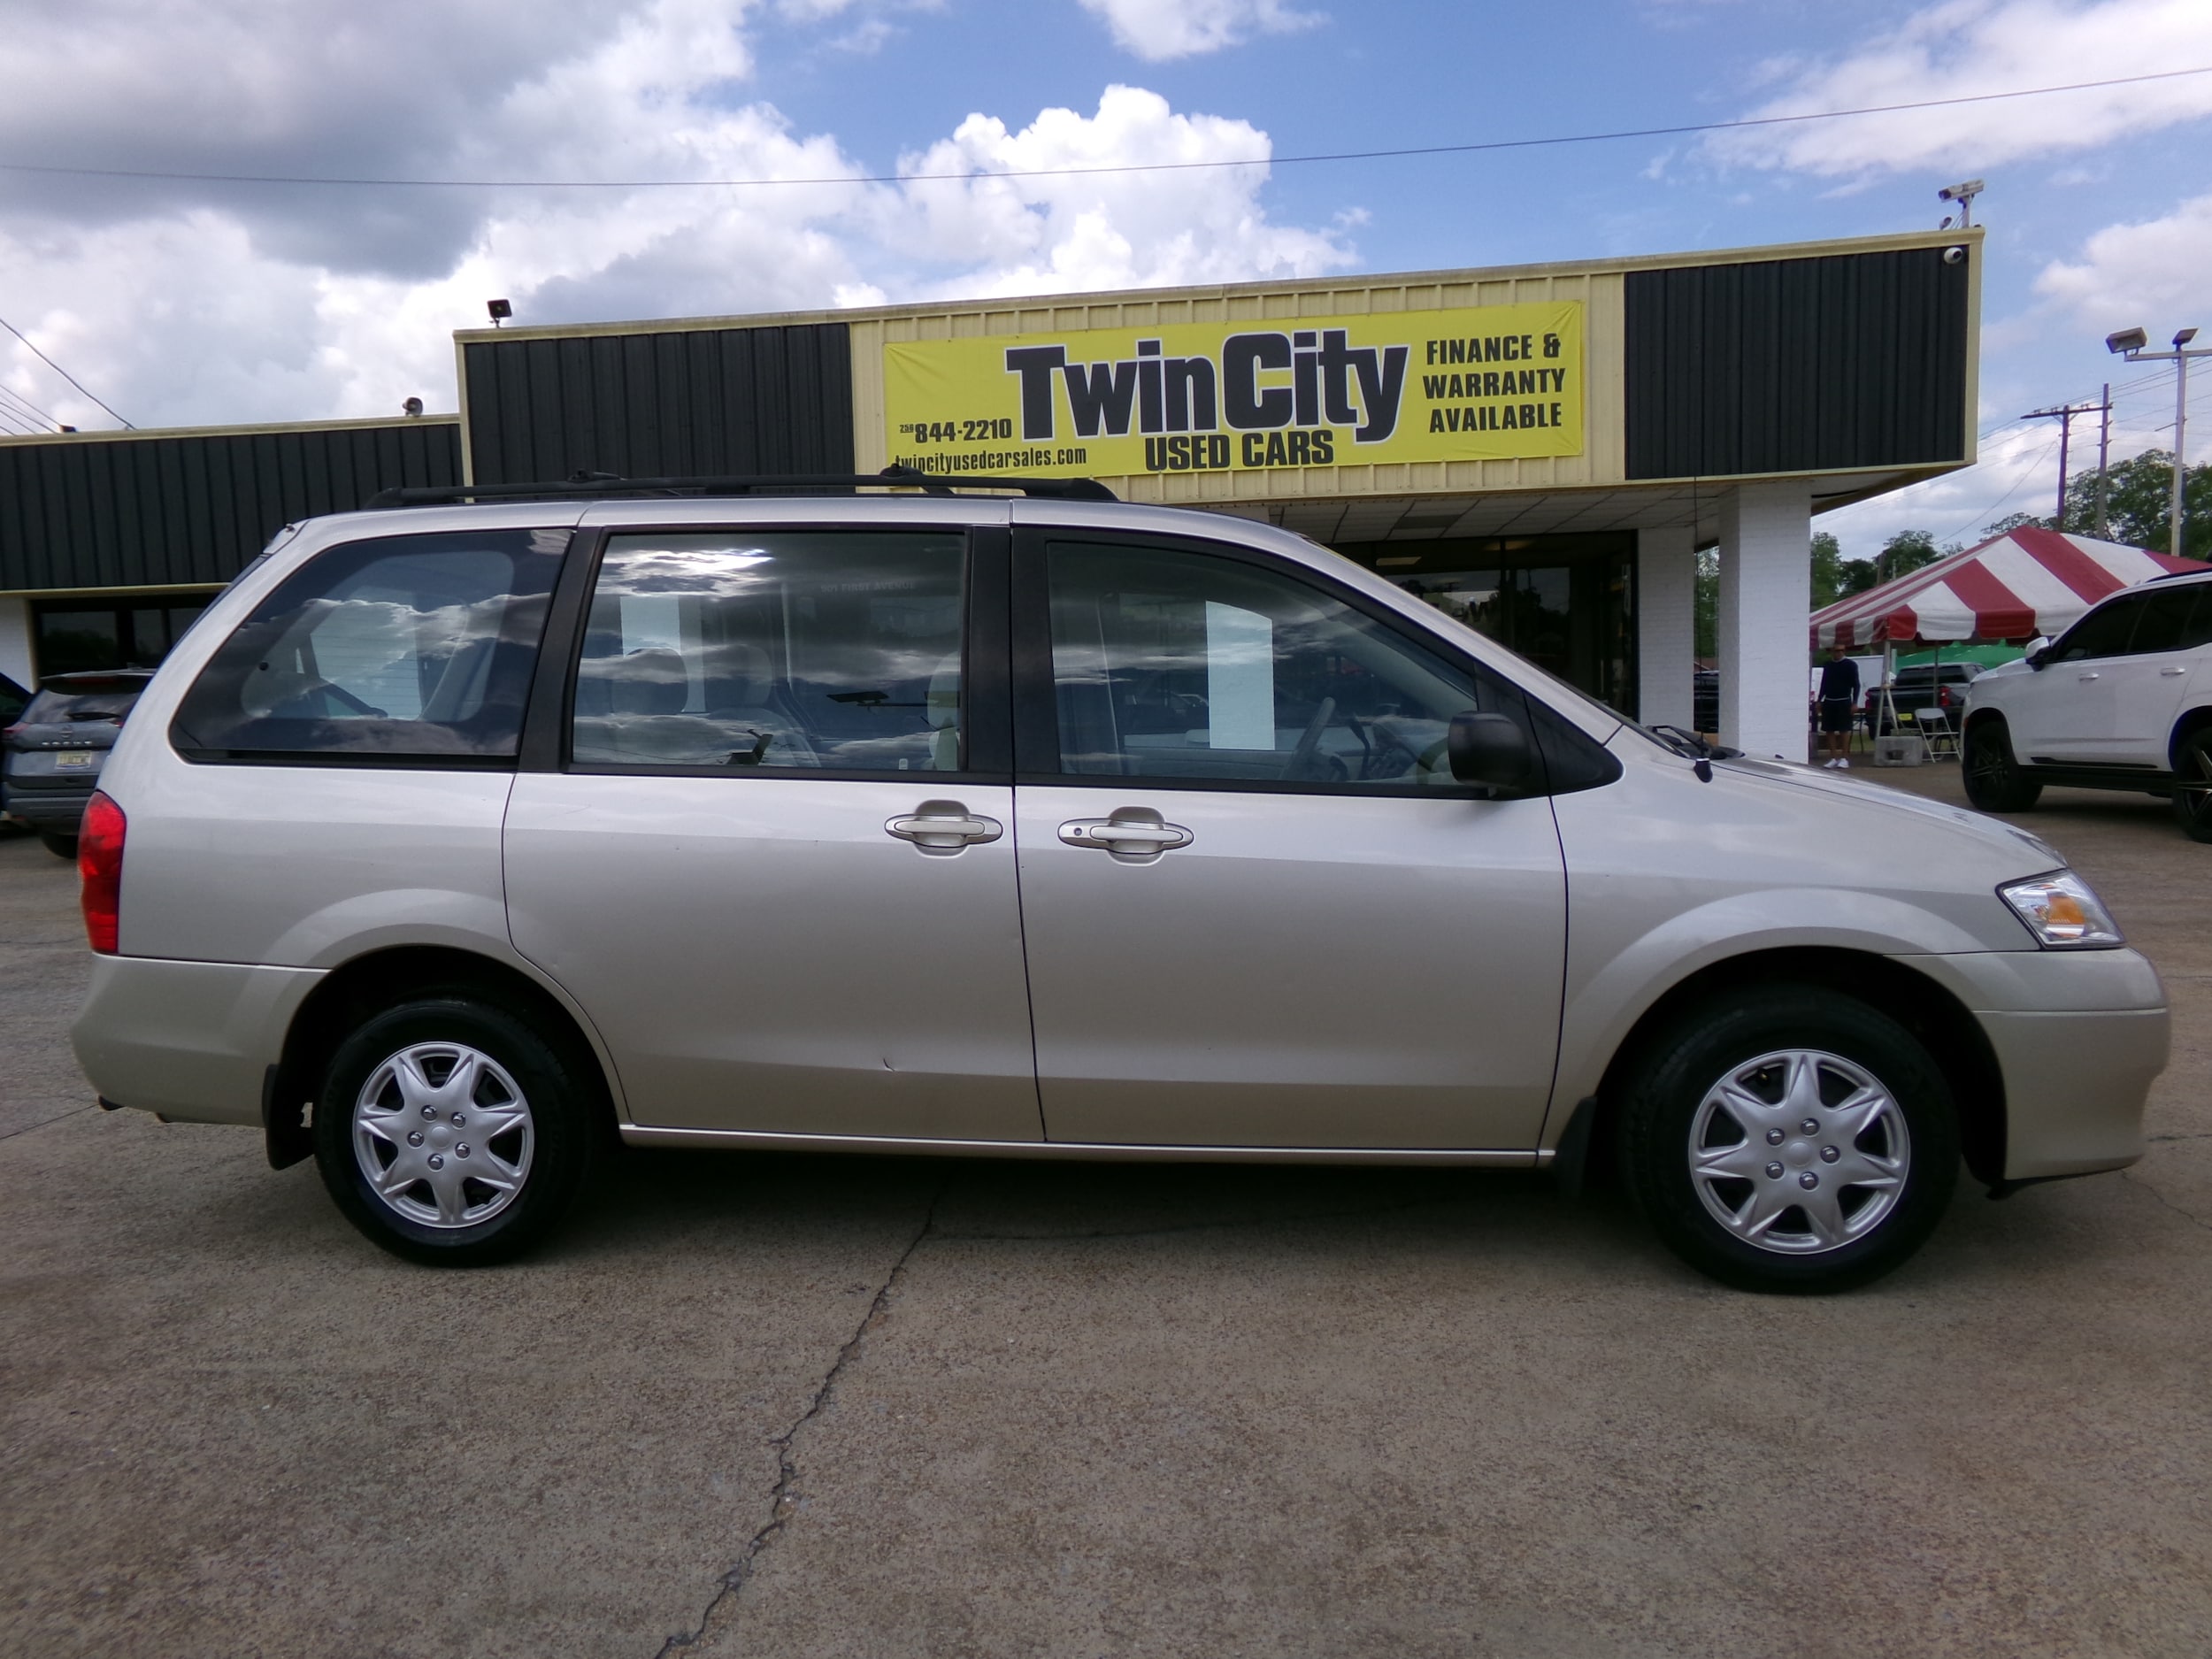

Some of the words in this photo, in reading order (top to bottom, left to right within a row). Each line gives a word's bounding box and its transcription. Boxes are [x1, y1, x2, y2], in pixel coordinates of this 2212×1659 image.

[1426, 334, 1532, 365] FINANCE
[1543, 333, 1561, 358] &
[1423, 368, 1565, 399] WARRANTY
[915, 419, 1011, 443] 844-2210
[1430, 403, 1562, 433] AVAILABLE
[1145, 434, 1231, 472] USED
[1241, 429, 1334, 467] CARS
